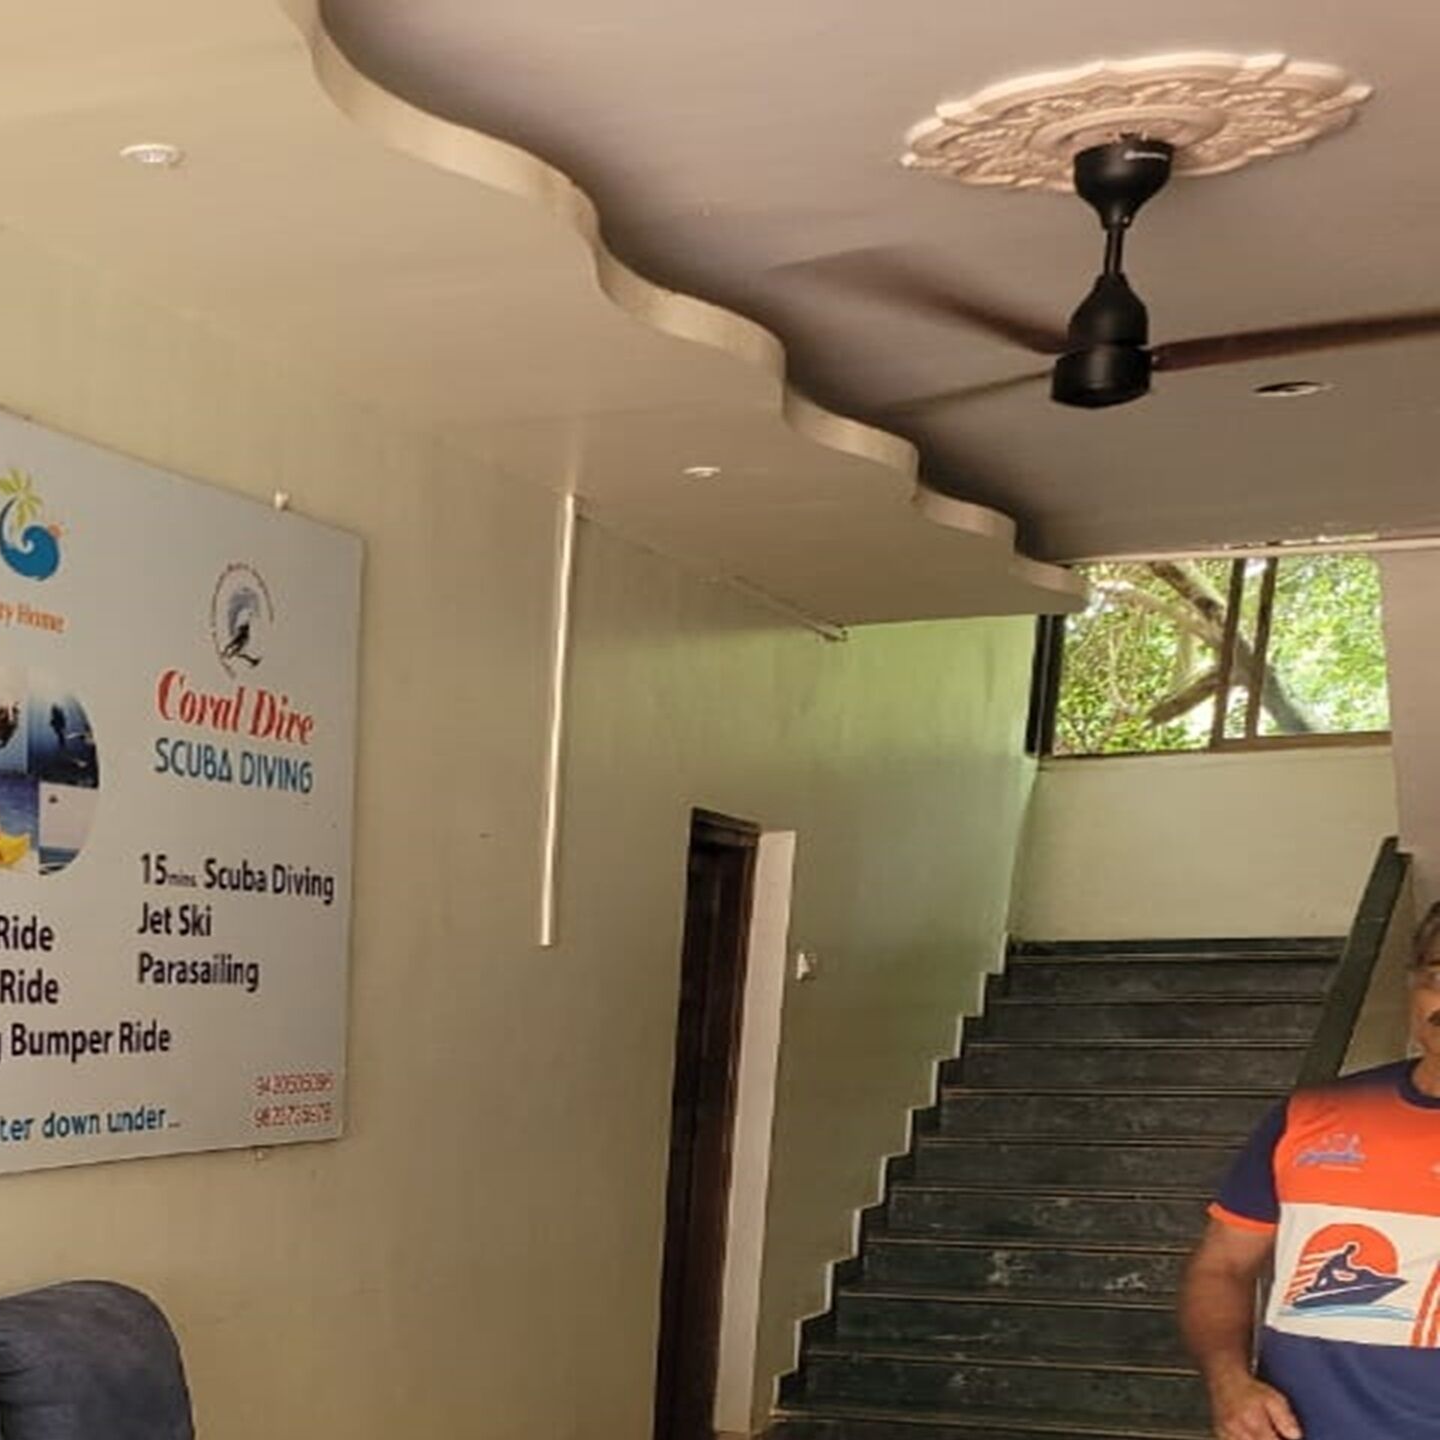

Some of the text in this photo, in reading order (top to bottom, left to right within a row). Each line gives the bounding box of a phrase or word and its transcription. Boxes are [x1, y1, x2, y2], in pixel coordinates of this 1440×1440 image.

[17, 602, 64, 633] Home
[158, 669, 245, 732] Coral
[155, 737, 312, 793] SCUBA DIVING
[204, 858, 267, 892] Scuba
[272, 864, 334, 905] Diving
[138, 903, 212, 936] Jet Ski
[0, 969, 59, 1004] Ride
[138, 953, 259, 993] Parasailing
[11, 1026, 112, 1069] Bumper
[118, 1020, 171, 1055] Ride
[42, 1112, 100, 1139] down
